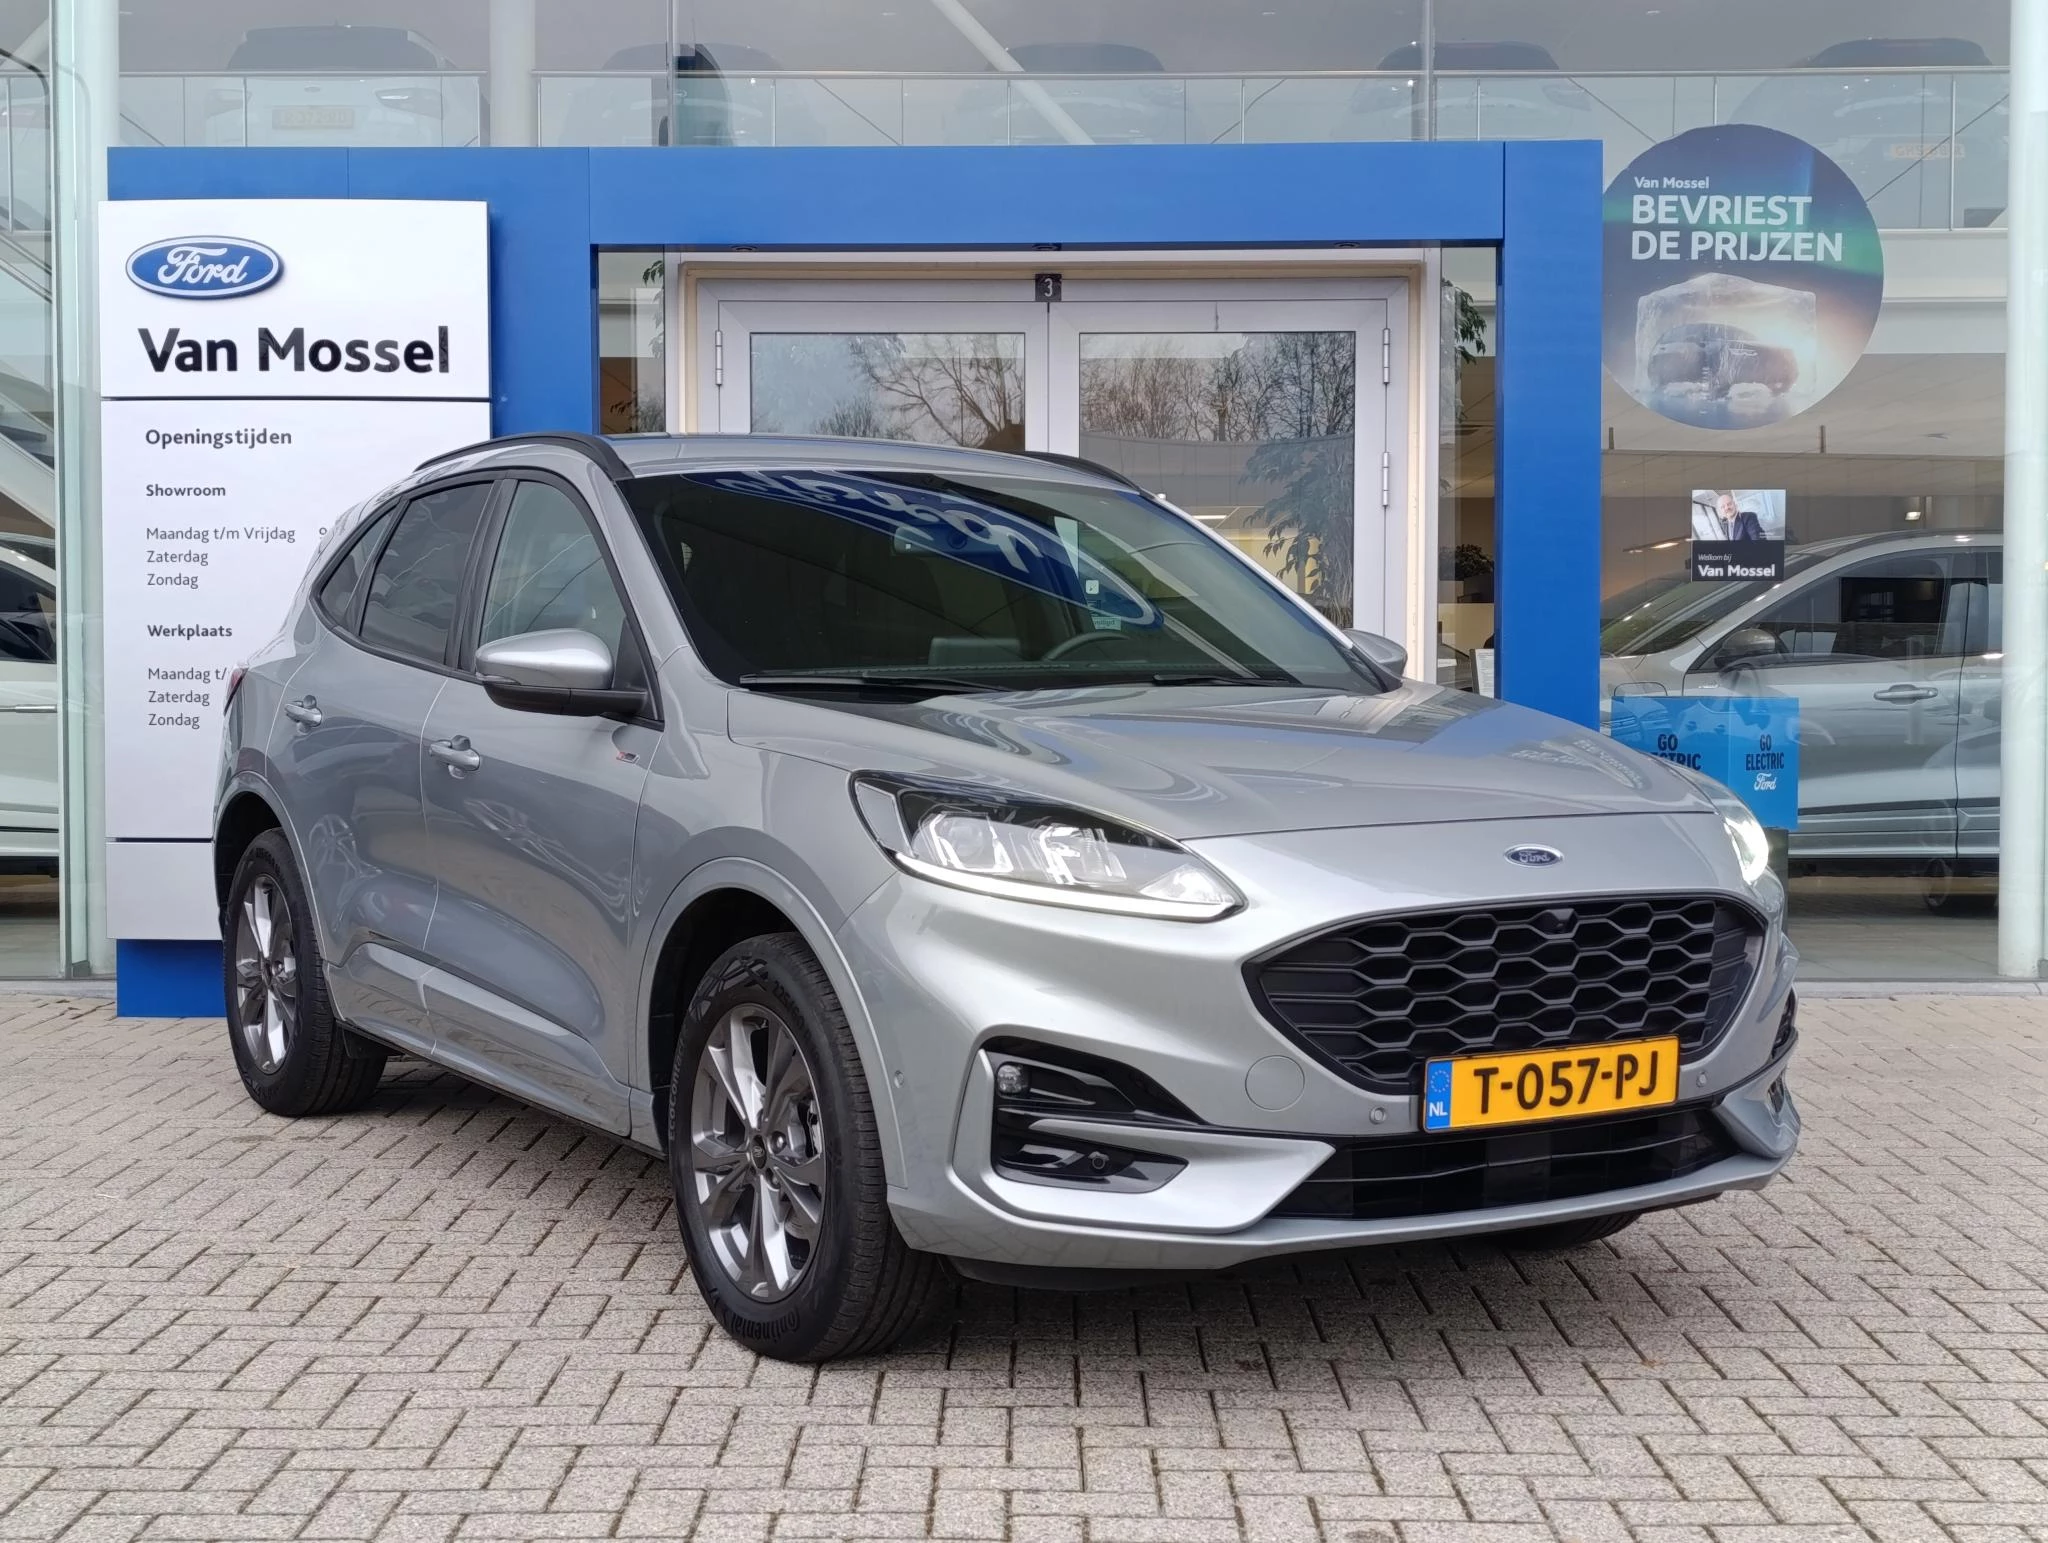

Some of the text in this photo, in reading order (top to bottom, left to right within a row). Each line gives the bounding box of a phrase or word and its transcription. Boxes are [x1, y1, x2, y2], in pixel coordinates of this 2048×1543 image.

[1634, 176, 1709, 189] Van Mossel
[1632, 194, 1812, 226] BEVRIEST
[1632, 230, 1843, 263] DE PRIJZEN
[157, 245, 251, 285] Ford
[1044, 278, 1053, 297] 3
[138, 325, 450, 374] Van Mossel
[145, 427, 292, 450] Openingstijden
[145, 483, 226, 498] Showroom
[146, 526, 296, 544] Maandag t/m Vrijdag
[146, 549, 209, 567] Zaterdag
[1724, 554, 1732, 563] bij
[1698, 564, 1776, 577] Van Mossel
[146, 572, 199, 590] Zondag
[147, 623, 233, 639] Werkplaats
[148, 666, 228, 685] Maandag t/
[148, 689, 211, 707] Zaterdag
[148, 712, 201, 730] Zondag
[1657, 733, 1678, 751] GO
[1759, 734, 1772, 751] GO
[1745, 751, 1785, 771] ELECTRIC
[1753, 772, 1777, 791] Ford
[1518, 850, 1551, 864] Ford
[1473, 1050, 1659, 1115] T-057-PJ
[1429, 1101, 1448, 1117] NL
